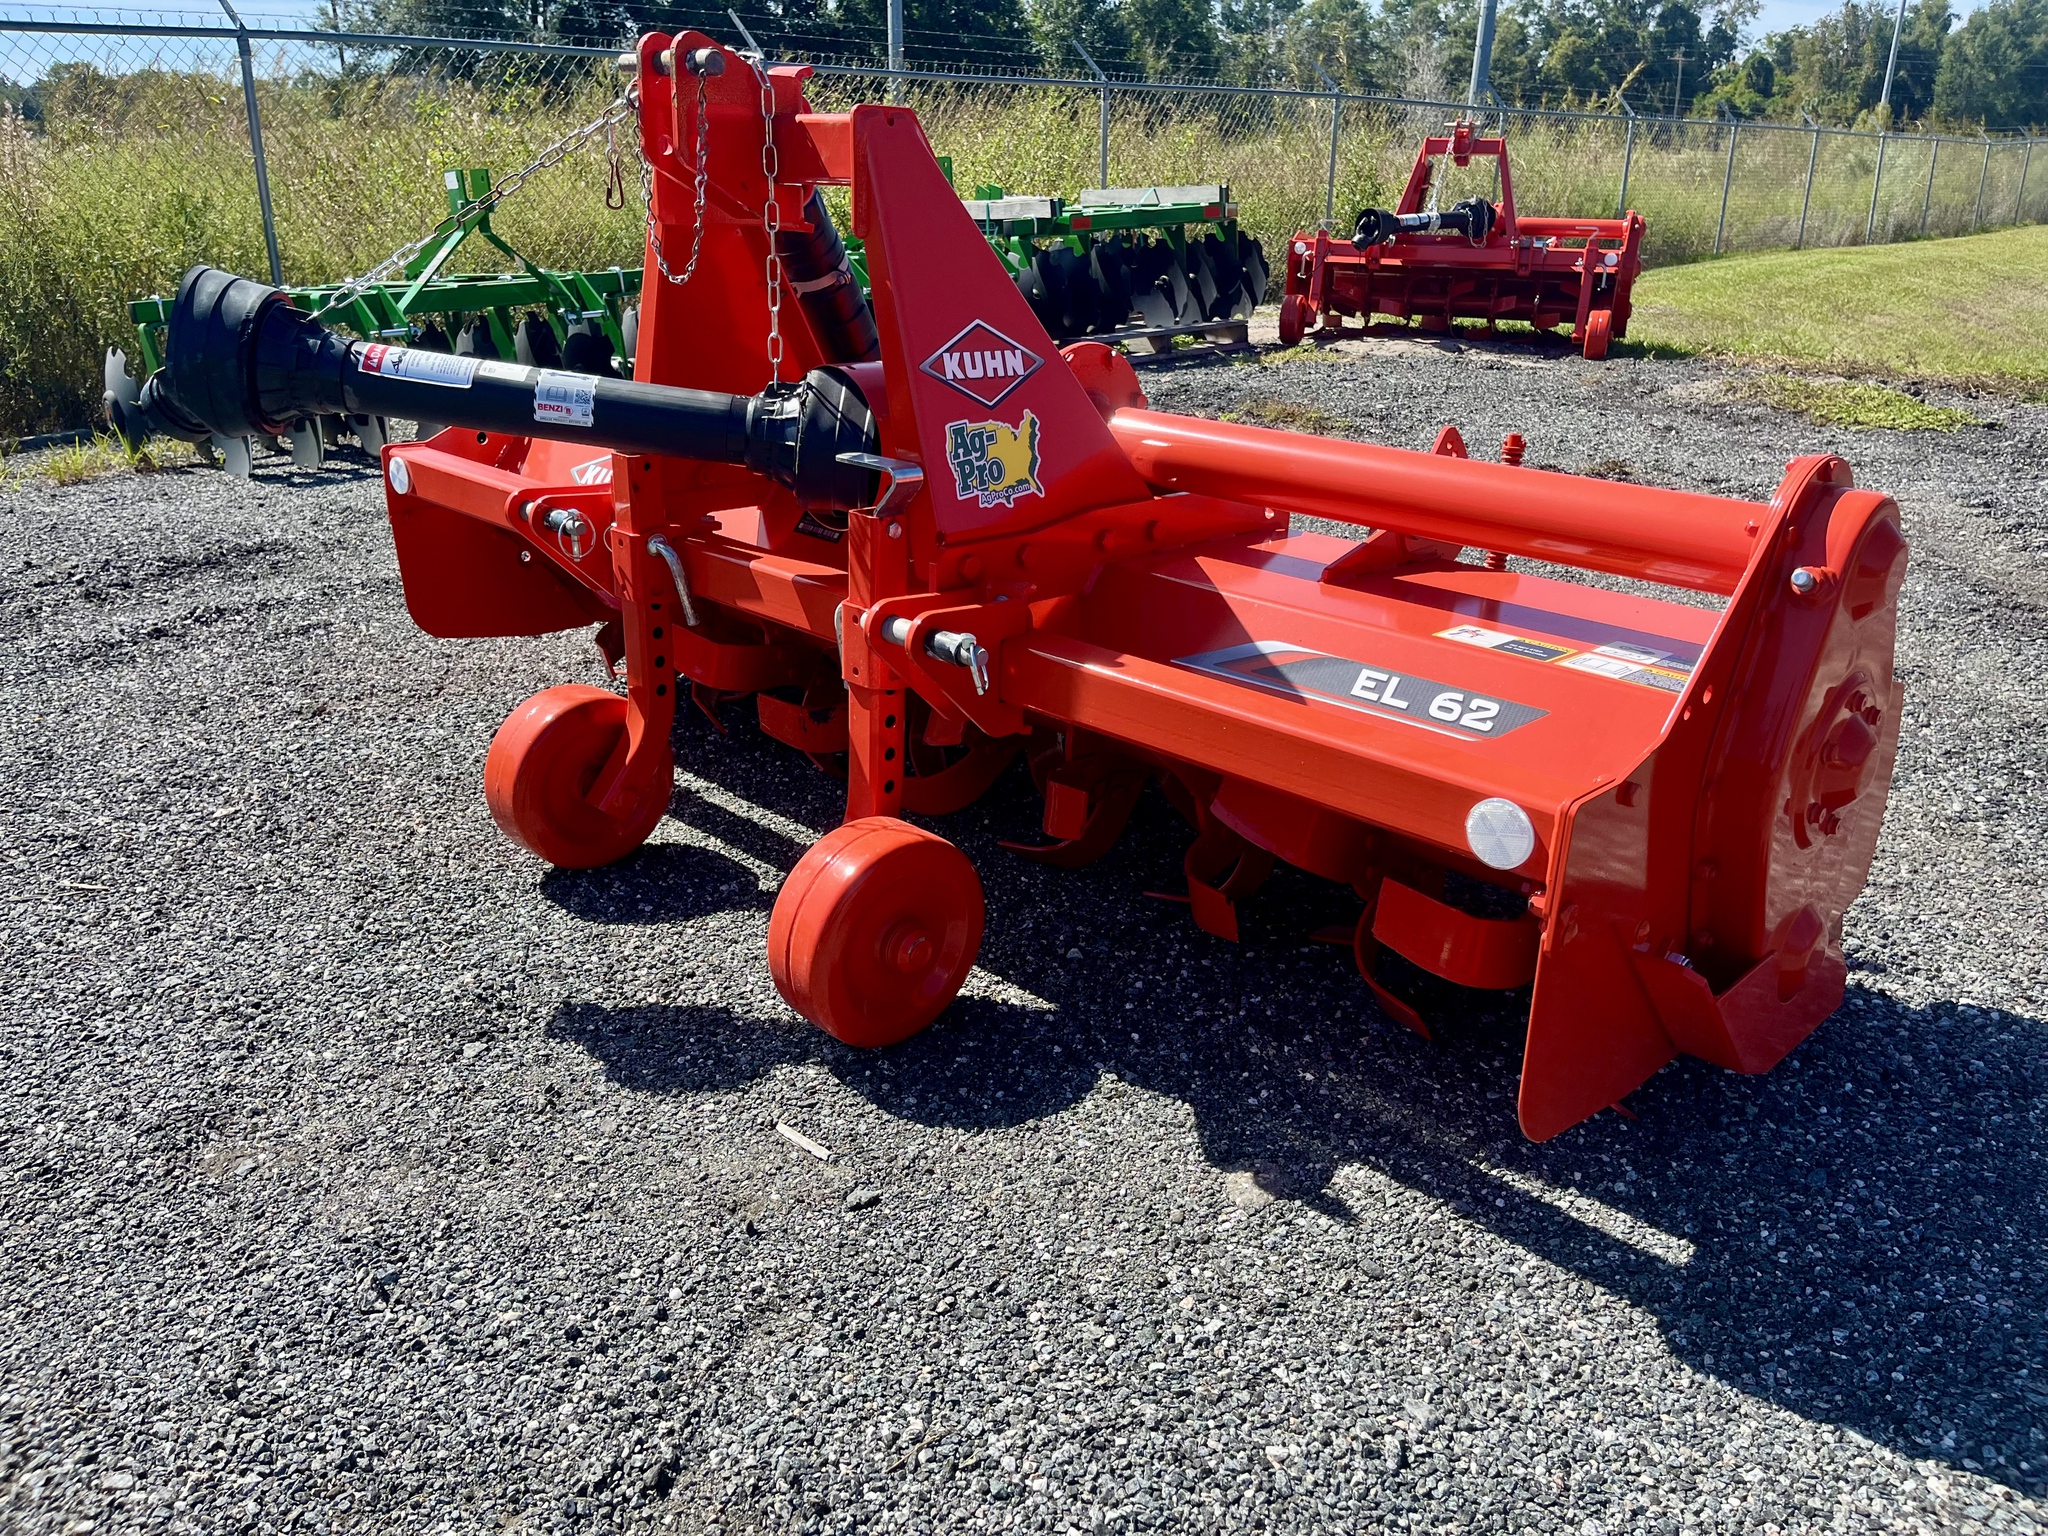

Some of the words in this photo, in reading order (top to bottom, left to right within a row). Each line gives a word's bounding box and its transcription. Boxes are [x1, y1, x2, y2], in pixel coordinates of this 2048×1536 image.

[942, 349, 1025, 381] KUHN
[537, 403, 563, 413] BENZI
[951, 426, 996, 464] Ag-
[956, 457, 1005, 495] Pro
[980, 482, 1031, 505] AgProCo.com
[1527, 640, 1571, 653] CAUTION
[1350, 668, 1409, 709] EL
[1428, 691, 1500, 733] 62
